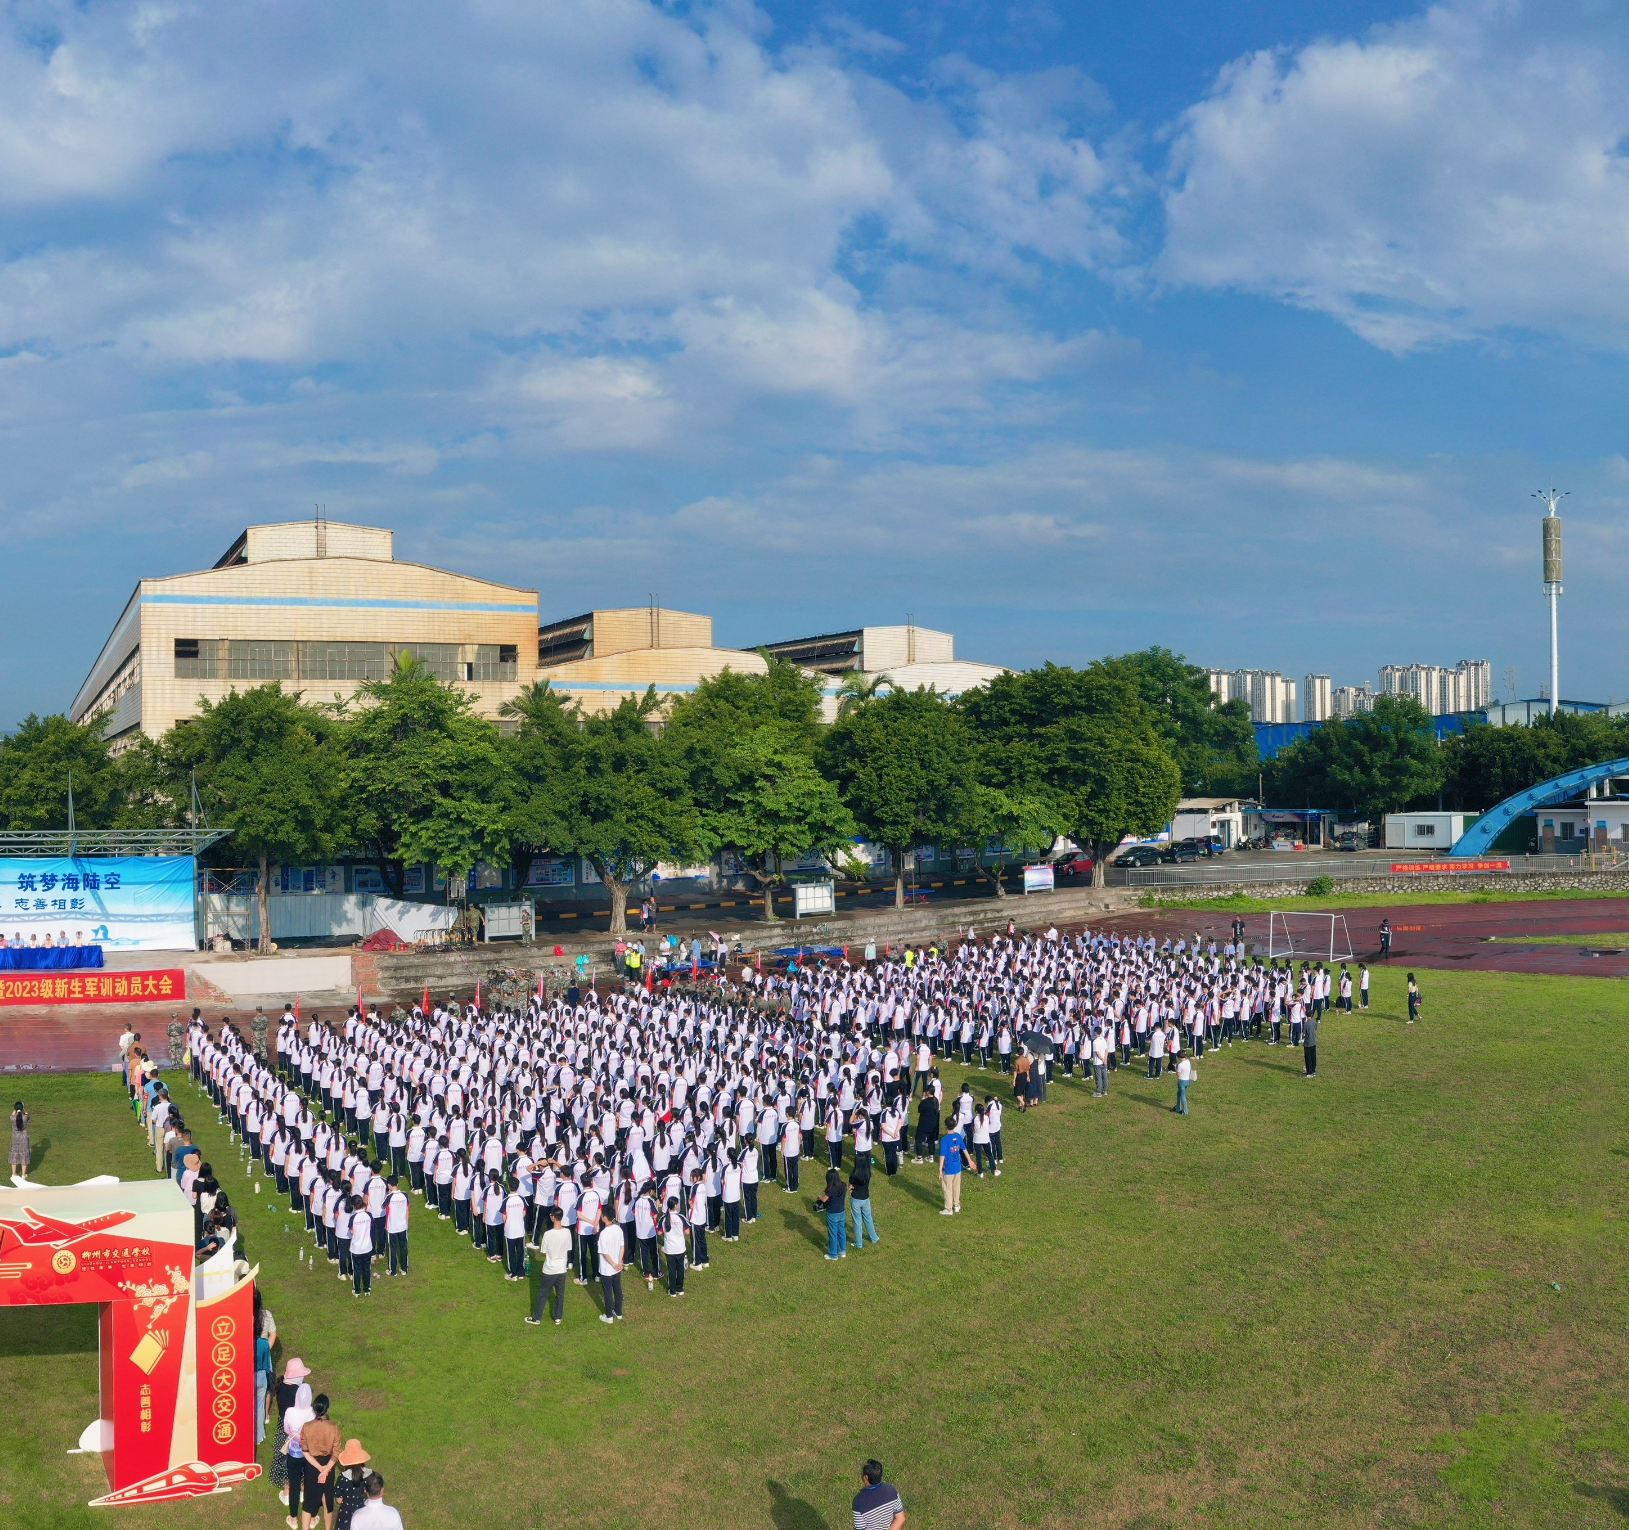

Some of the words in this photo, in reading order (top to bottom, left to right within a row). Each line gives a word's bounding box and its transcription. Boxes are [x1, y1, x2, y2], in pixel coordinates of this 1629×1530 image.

[1396, 864, 1421, 872] 严格训练
[1422, 863, 1447, 871] 严格要求
[1449, 862, 1474, 870] 努力学习
[17, 872, 121, 892] 筑梦海陆空
[14, 897, 86, 911] 志善相彰
[213, 1317, 234, 1443] 立足大交通
[140, 1383, 151, 1432] 志善相彰
